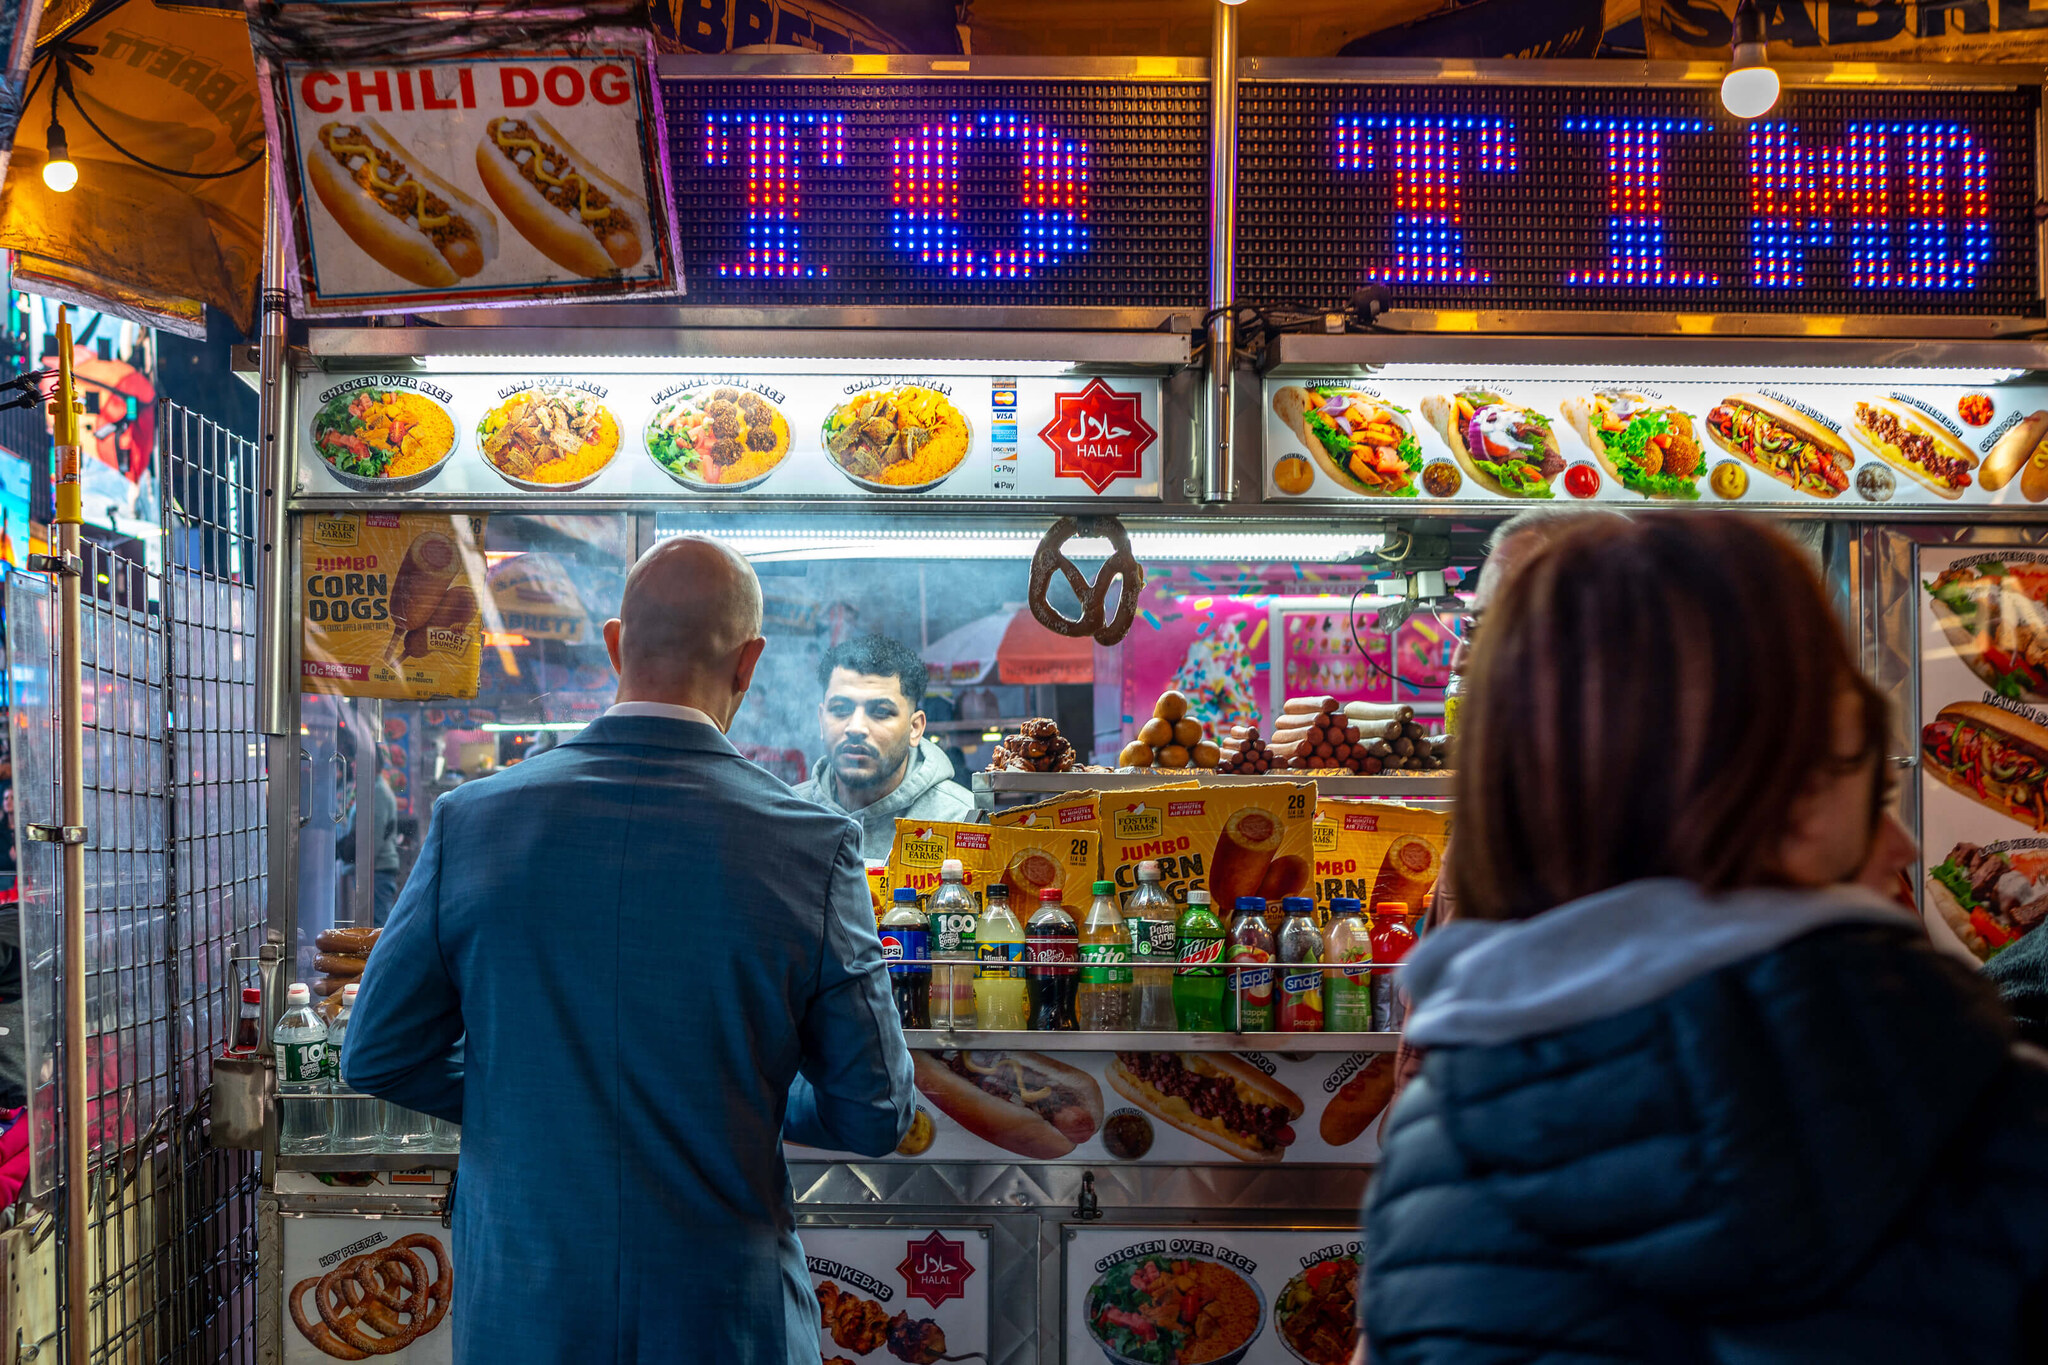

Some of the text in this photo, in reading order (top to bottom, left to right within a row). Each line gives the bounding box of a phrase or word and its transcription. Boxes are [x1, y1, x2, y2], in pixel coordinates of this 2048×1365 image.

[301, 64, 631, 114] CHILI DOG
[705, 113, 1088, 278] TO
[319, 374, 453, 404] CHICKEN OVER RICE
[751, 382, 786, 404] RICE
[843, 375, 952, 396] COMBO PLATTER
[1305, 378, 1352, 389] CHICKEN
[996, 412, 1013, 420] VISA
[1067, 409, 1132, 443] حلال
[1979, 409, 2024, 453] CORN DOG
[1076, 444, 1123, 457] HALAL
[1002, 464, 1016, 474] Pay
[1001, 481, 1015, 491] Pay
[318, 521, 356, 532] FOSTER
[314, 554, 378, 573] JUMBO
[307, 573, 388, 598] CORN
[308, 597, 389, 622] DOGS
[429, 631, 467, 646] HONEY
[429, 640, 463, 652] CRUNCHY
[325, 664, 362, 675] PROTEIN
[1981, 689, 2037, 721] ITALIAN
[1288, 794, 1306, 810] 28
[1118, 816, 1158, 826] FOSTER
[904, 842, 944, 853] FOSTER
[1070, 838, 1088, 856] 28
[1120, 835, 1190, 861] JUMBO
[1315, 858, 1357, 876] MBO
[904, 871, 973, 890] JUMO
[937, 914, 976, 933] 100
[1150, 932, 1176, 947] Sprin
[883, 948, 902, 956] EPSI
[983, 954, 1007, 962] Minute
[1079, 946, 1125, 969] prite
[1248, 1051, 1278, 1077] DOG
[1322, 1056, 1357, 1094] CORN
[318, 1231, 389, 1268] HOT PRETZEL
[1094, 1238, 1257, 1275] CHICKEN OVER RICE
[1299, 1243, 1344, 1270] LAMB
[915, 1252, 959, 1275] حلال
[840, 1265, 894, 1303] KEBAB
[921, 1275, 952, 1285] HALAL
